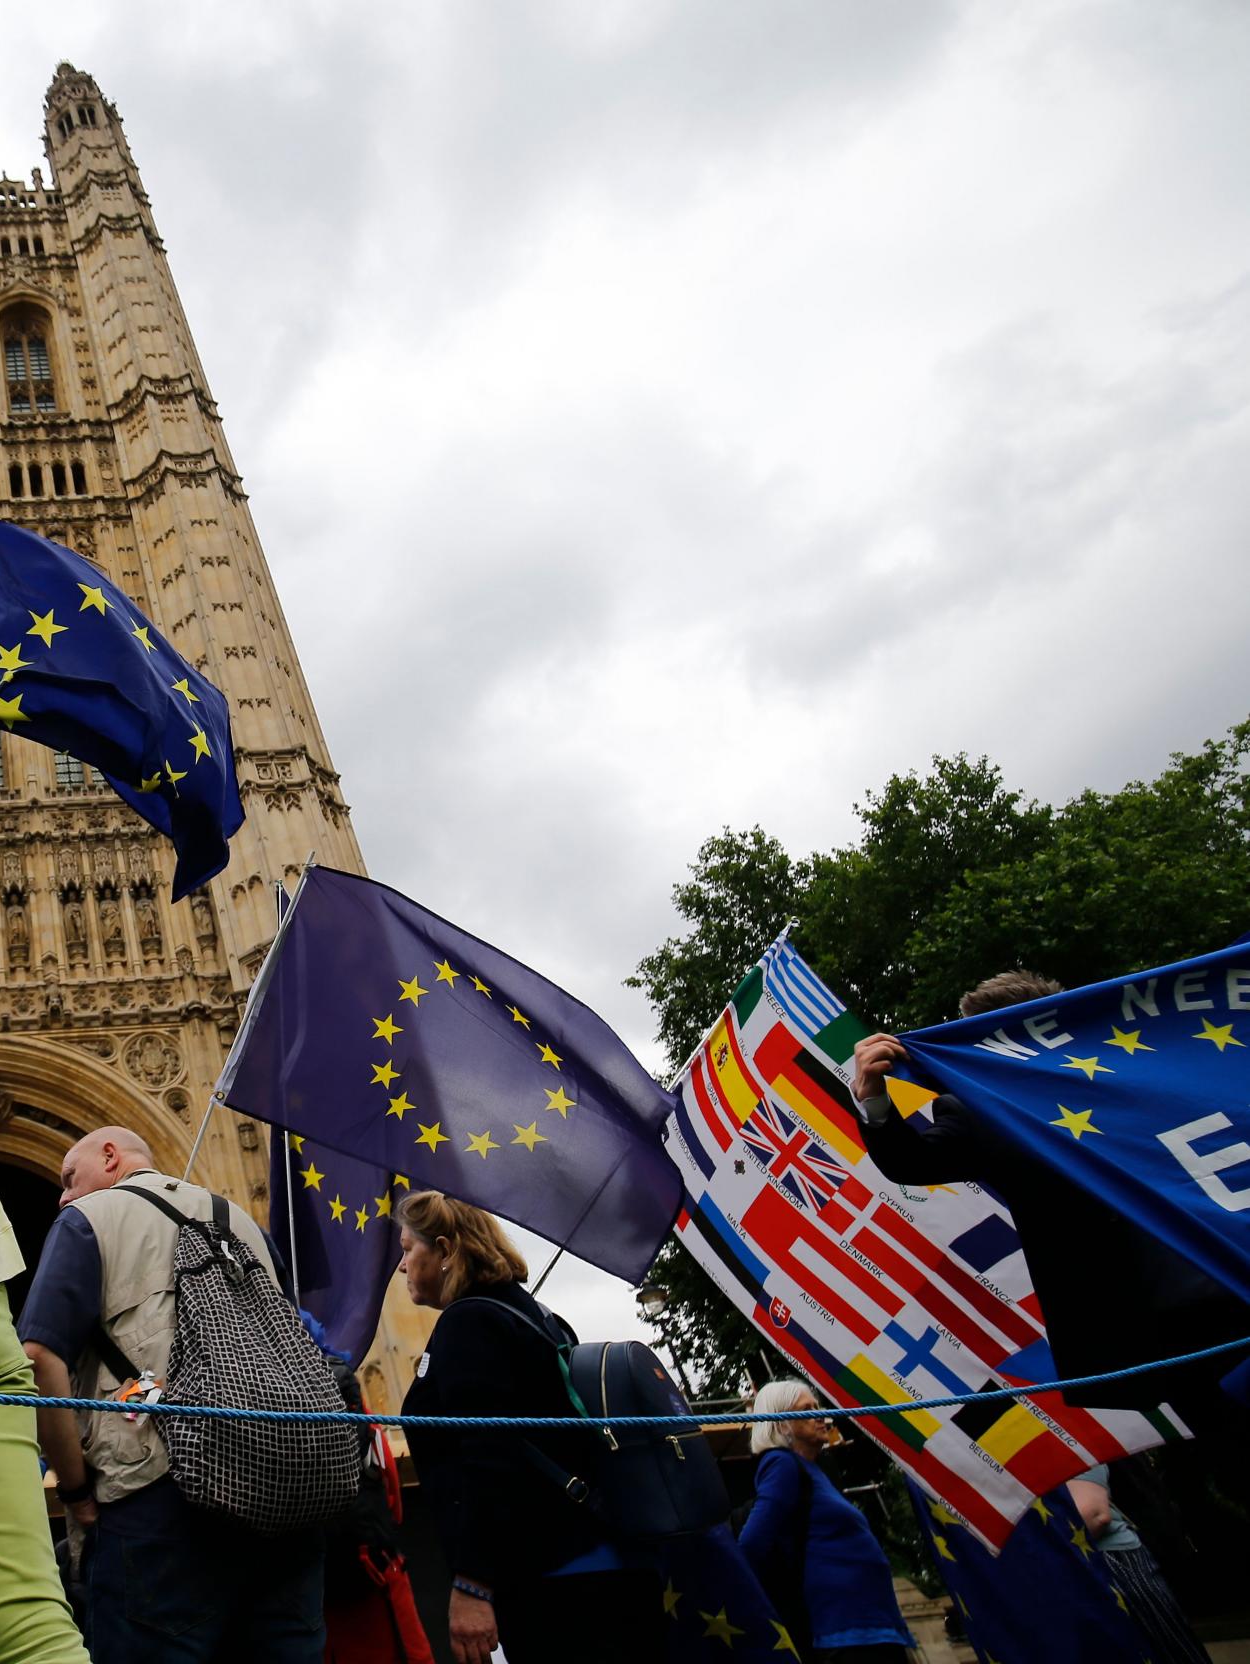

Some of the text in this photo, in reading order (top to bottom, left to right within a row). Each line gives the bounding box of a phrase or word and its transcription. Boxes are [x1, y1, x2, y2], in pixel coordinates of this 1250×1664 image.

[973, 1009, 1074, 1061] WE
[706, 1081, 719, 1106] SPAIN
[788, 1110, 828, 1148] GERMANY
[742, 1146, 804, 1210] UNITED KINGDOM
[878, 1191, 915, 1223] CYPRUS
[726, 1213, 747, 1240] MALTA
[839, 1240, 885, 1279] DENMARK
[974, 1273, 1016, 1306] FRANCE
[799, 1291, 836, 1326] AUSTRIA
[935, 1324, 962, 1350] LATVIA
[889, 1371, 923, 1401] FINLAND
[1002, 1381, 1078, 1448] CCH REPUBLIC
[968, 1441, 1004, 1475] BELGIUM
